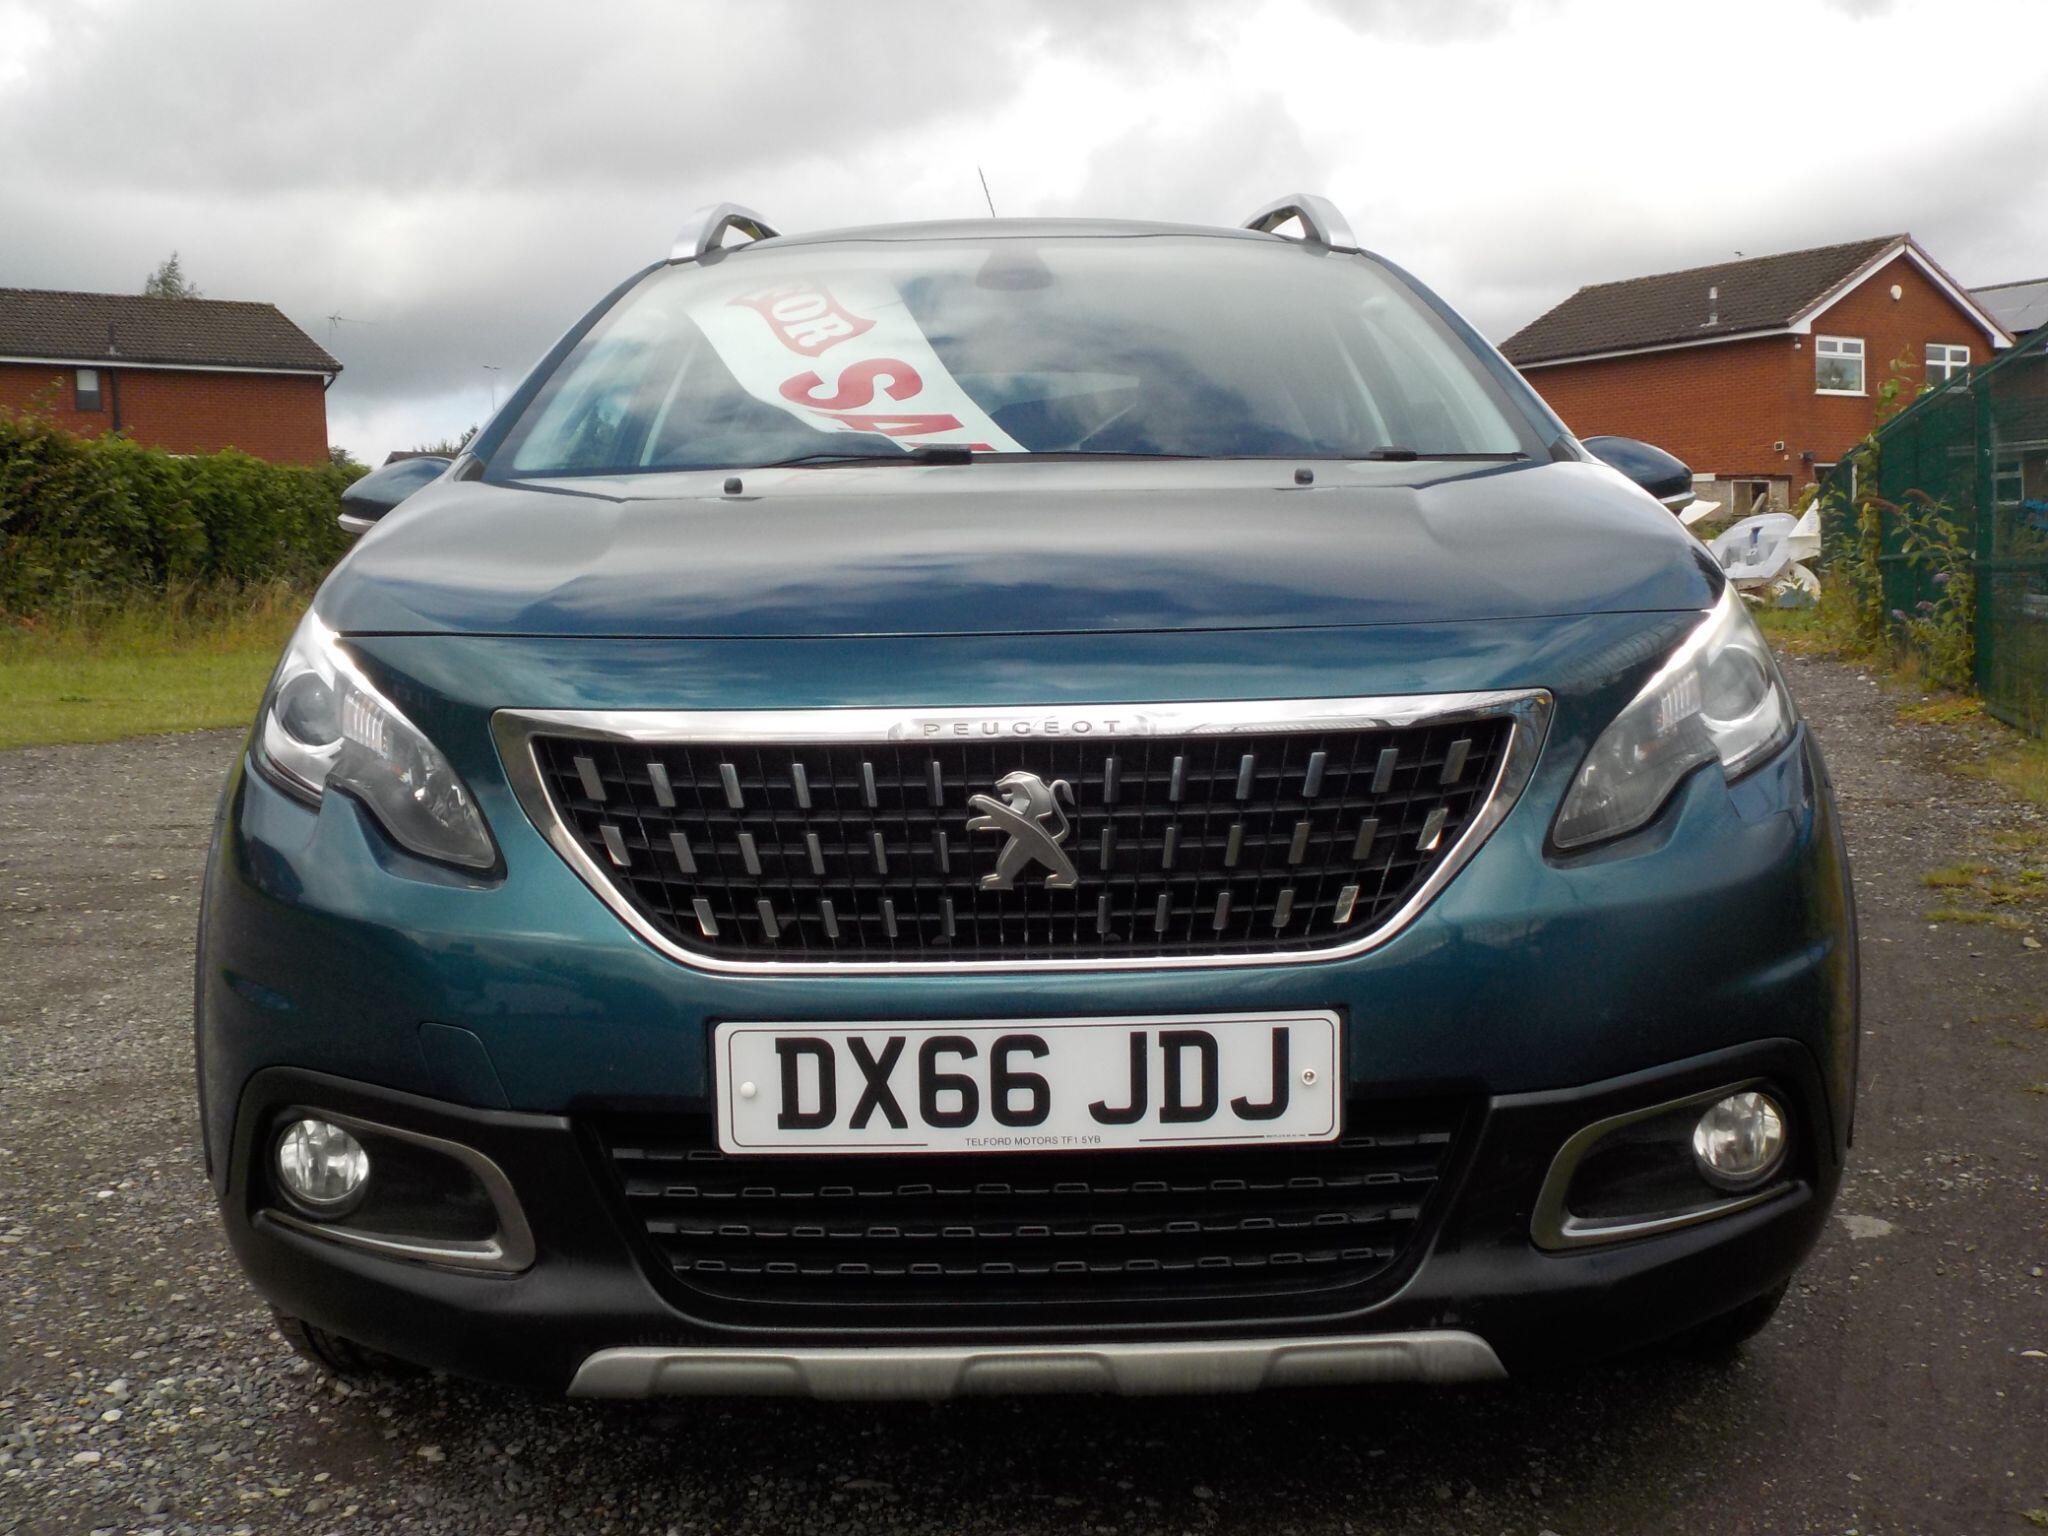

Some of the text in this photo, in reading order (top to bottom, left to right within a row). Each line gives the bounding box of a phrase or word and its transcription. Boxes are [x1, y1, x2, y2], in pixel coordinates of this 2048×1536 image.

[923, 721, 1121, 736] PEUGEOT
[775, 1027, 1291, 1130] DX66 JDJ
[965, 1135, 1101, 1146] TELFORD MOTORS TF1 5YB
